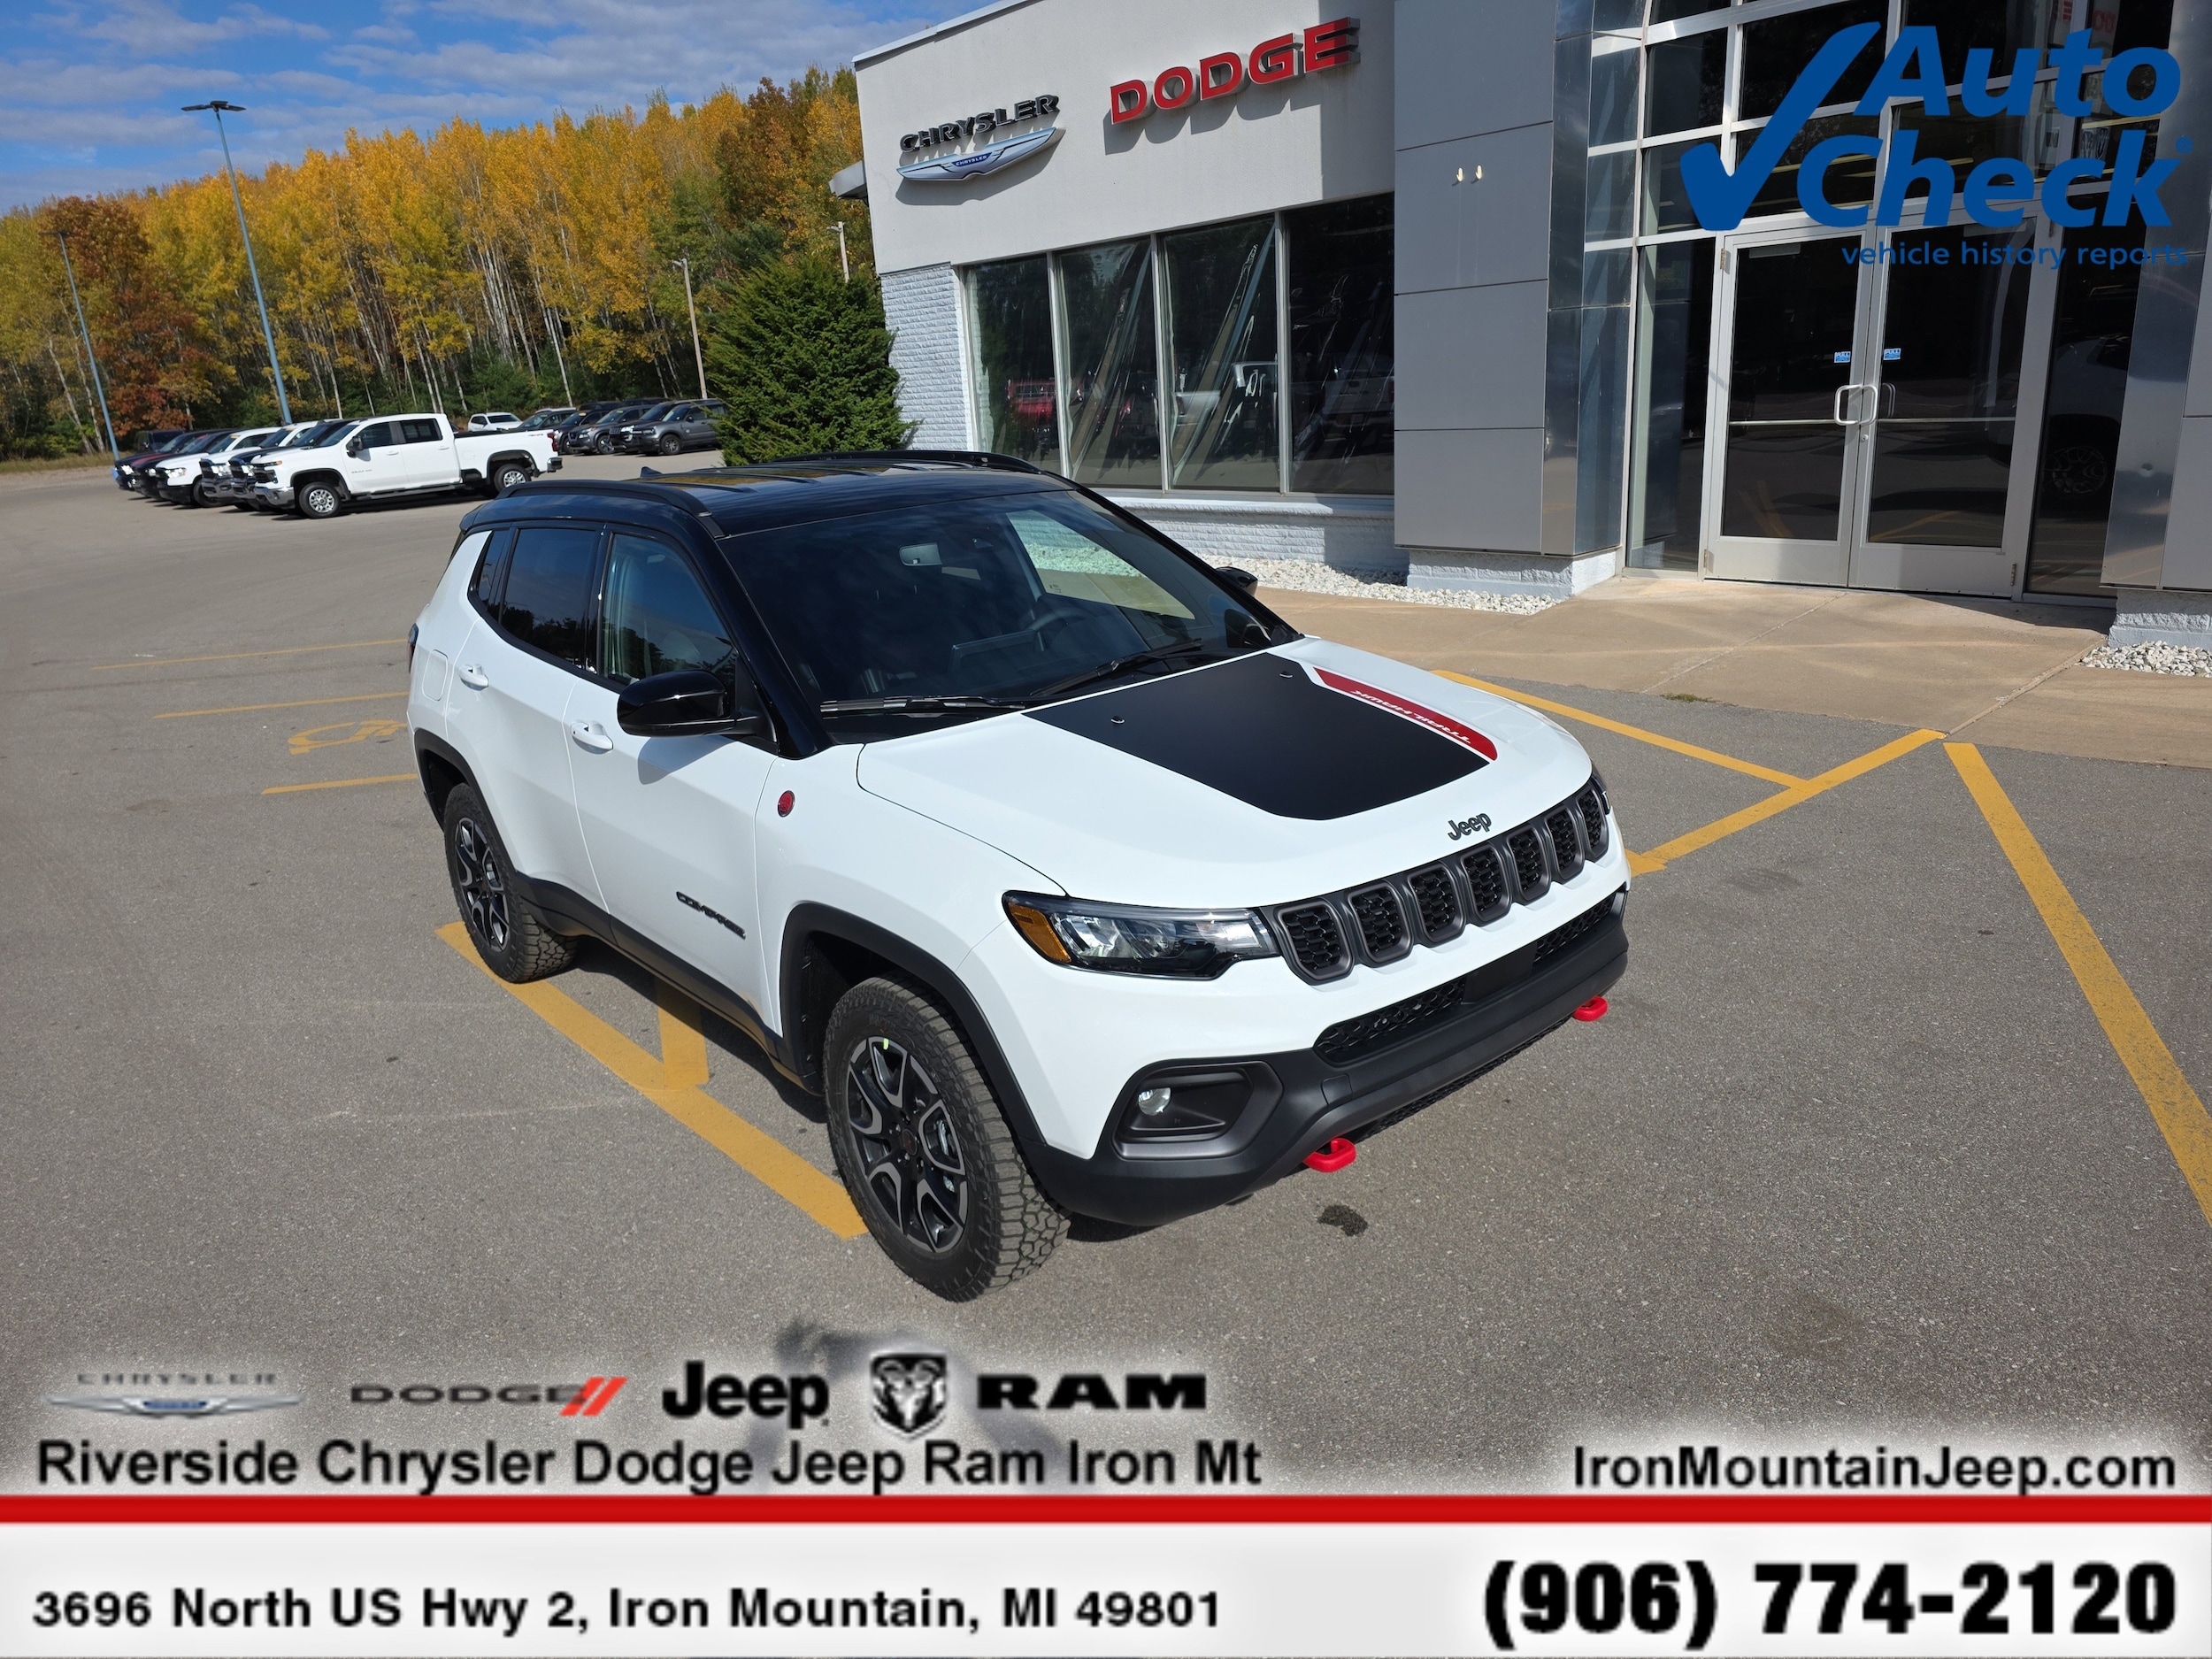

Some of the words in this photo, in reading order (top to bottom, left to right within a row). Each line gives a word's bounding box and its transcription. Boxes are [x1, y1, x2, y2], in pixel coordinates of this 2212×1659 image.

[1110, 17, 1356, 125] DODGE
[900, 94, 1060, 153] CHRYSLER
[955, 155, 988, 167] CHRYSLER
[1448, 812, 1492, 841] Jeep
